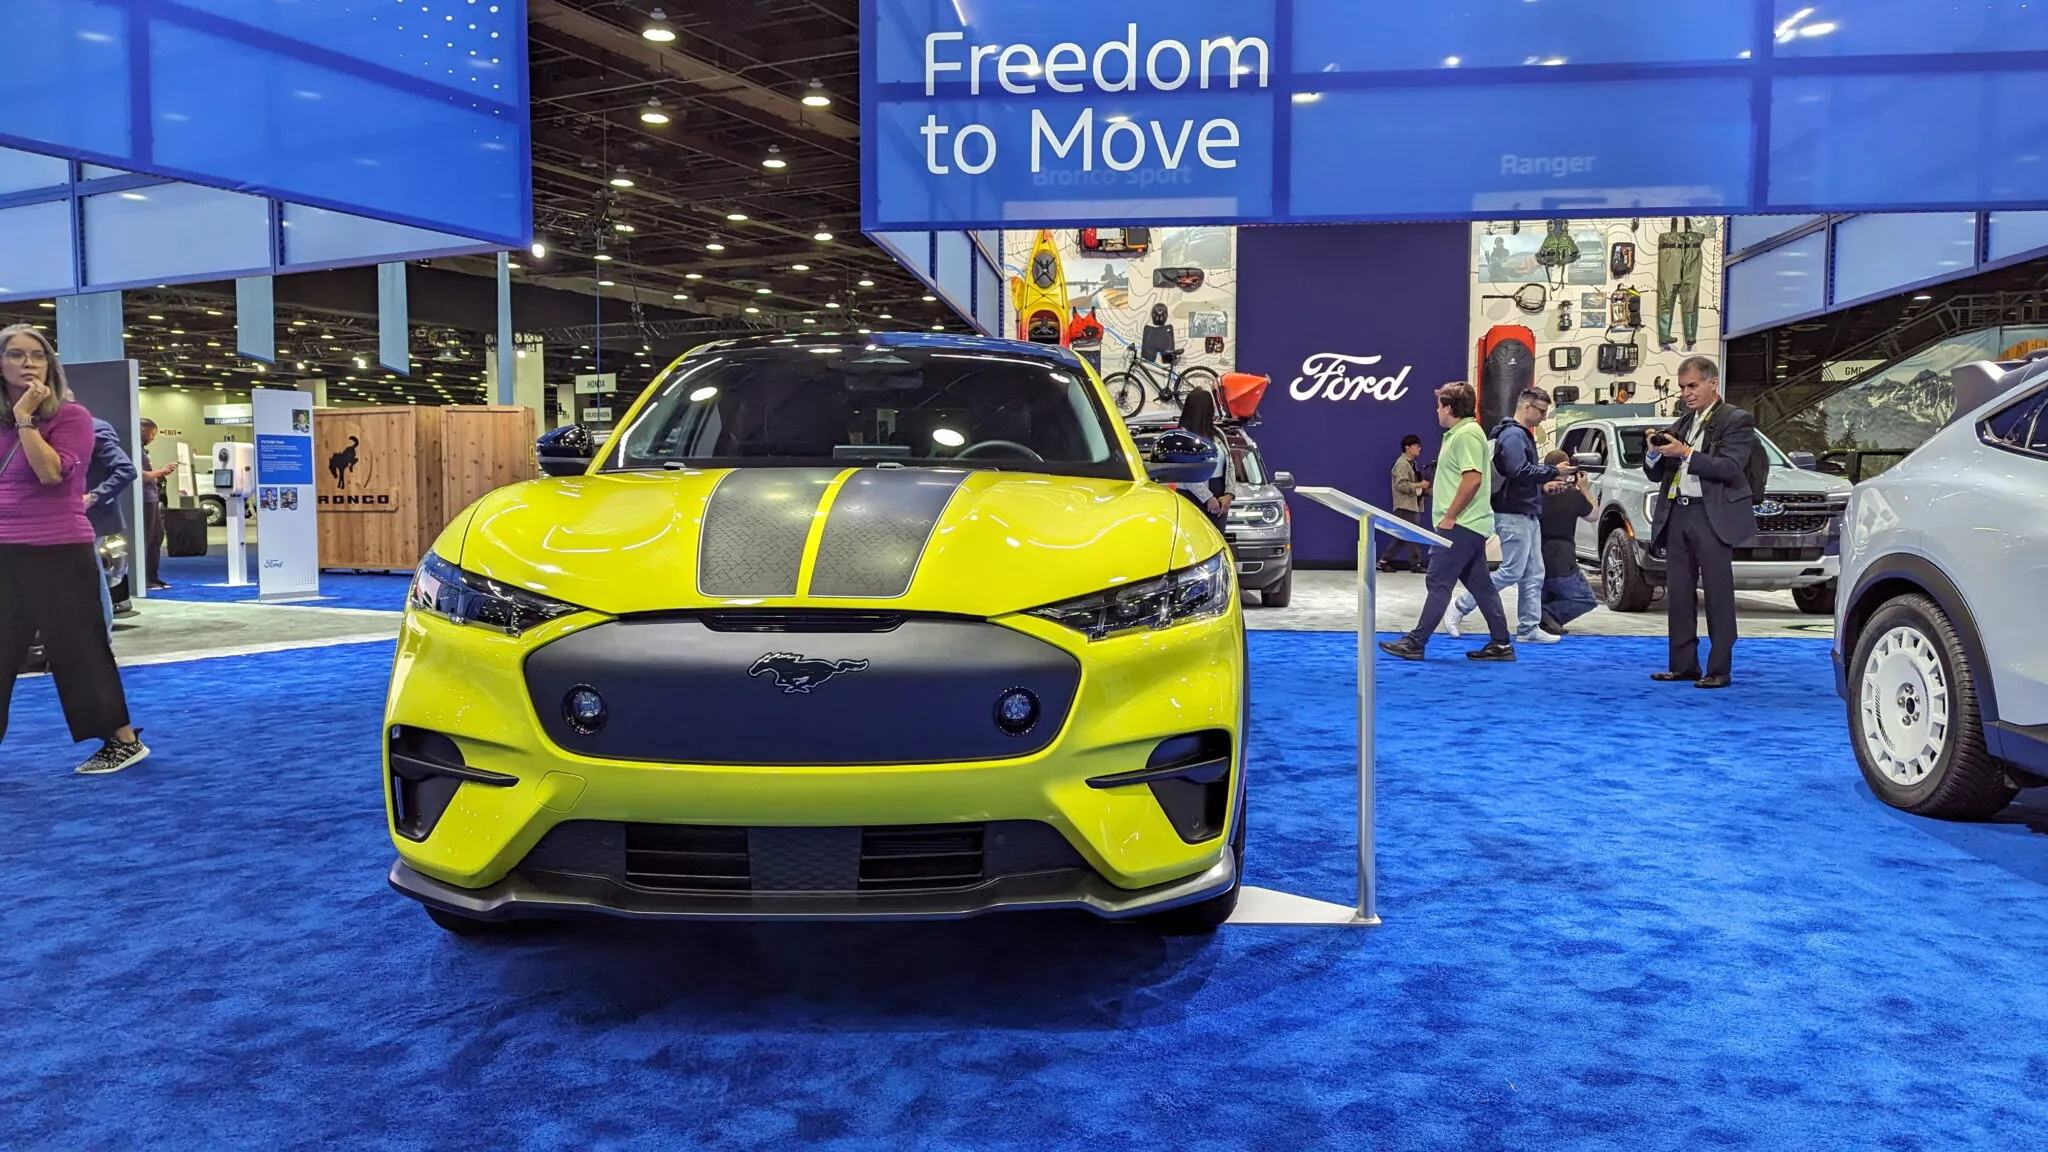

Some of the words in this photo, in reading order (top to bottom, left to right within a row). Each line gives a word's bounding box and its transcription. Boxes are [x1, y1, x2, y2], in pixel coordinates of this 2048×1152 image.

[925, 23, 1269, 96] Freedom
[920, 114, 997, 175] to
[1031, 108, 1240, 173] Move
[1033, 166, 1117, 186] Bronco
[1501, 154, 1596, 178] Ranger
[1290, 353, 1412, 401] Ford
[317, 495, 389, 505] RONCO
